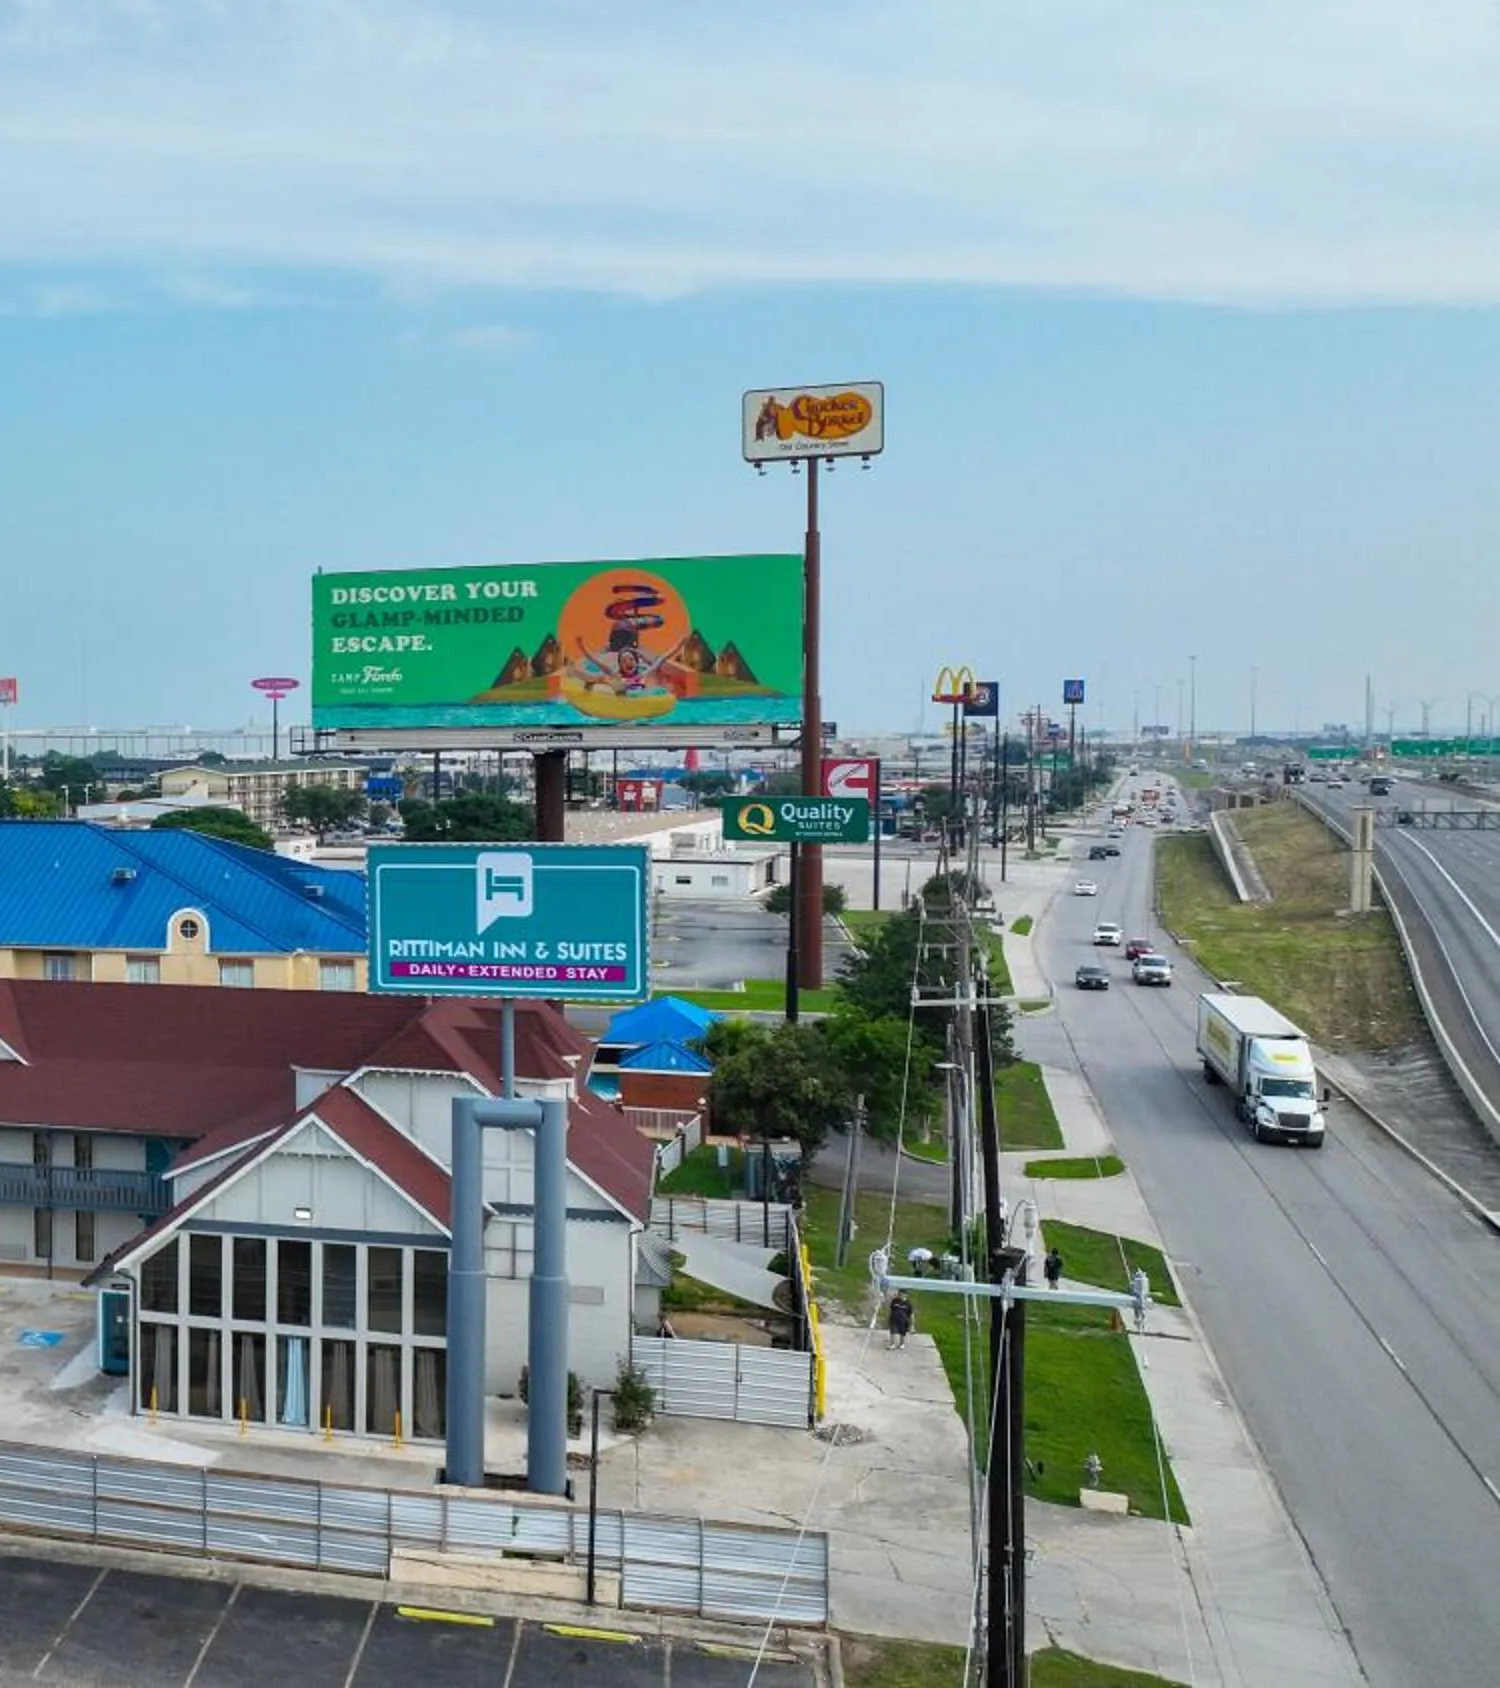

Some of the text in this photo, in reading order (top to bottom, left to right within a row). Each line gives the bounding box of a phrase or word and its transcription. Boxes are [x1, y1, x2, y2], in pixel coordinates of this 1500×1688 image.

[331, 580, 538, 605] DISCOVER YOUR
[331, 605, 525, 629] GLAMP-MINDED
[331, 634, 433, 653] ESCAPE.
[780, 802, 854, 825] Quality
[388, 939, 628, 961] RITTIMAN INN & SUITES
[409, 963, 608, 980] DAILY EXTENDED STAY
